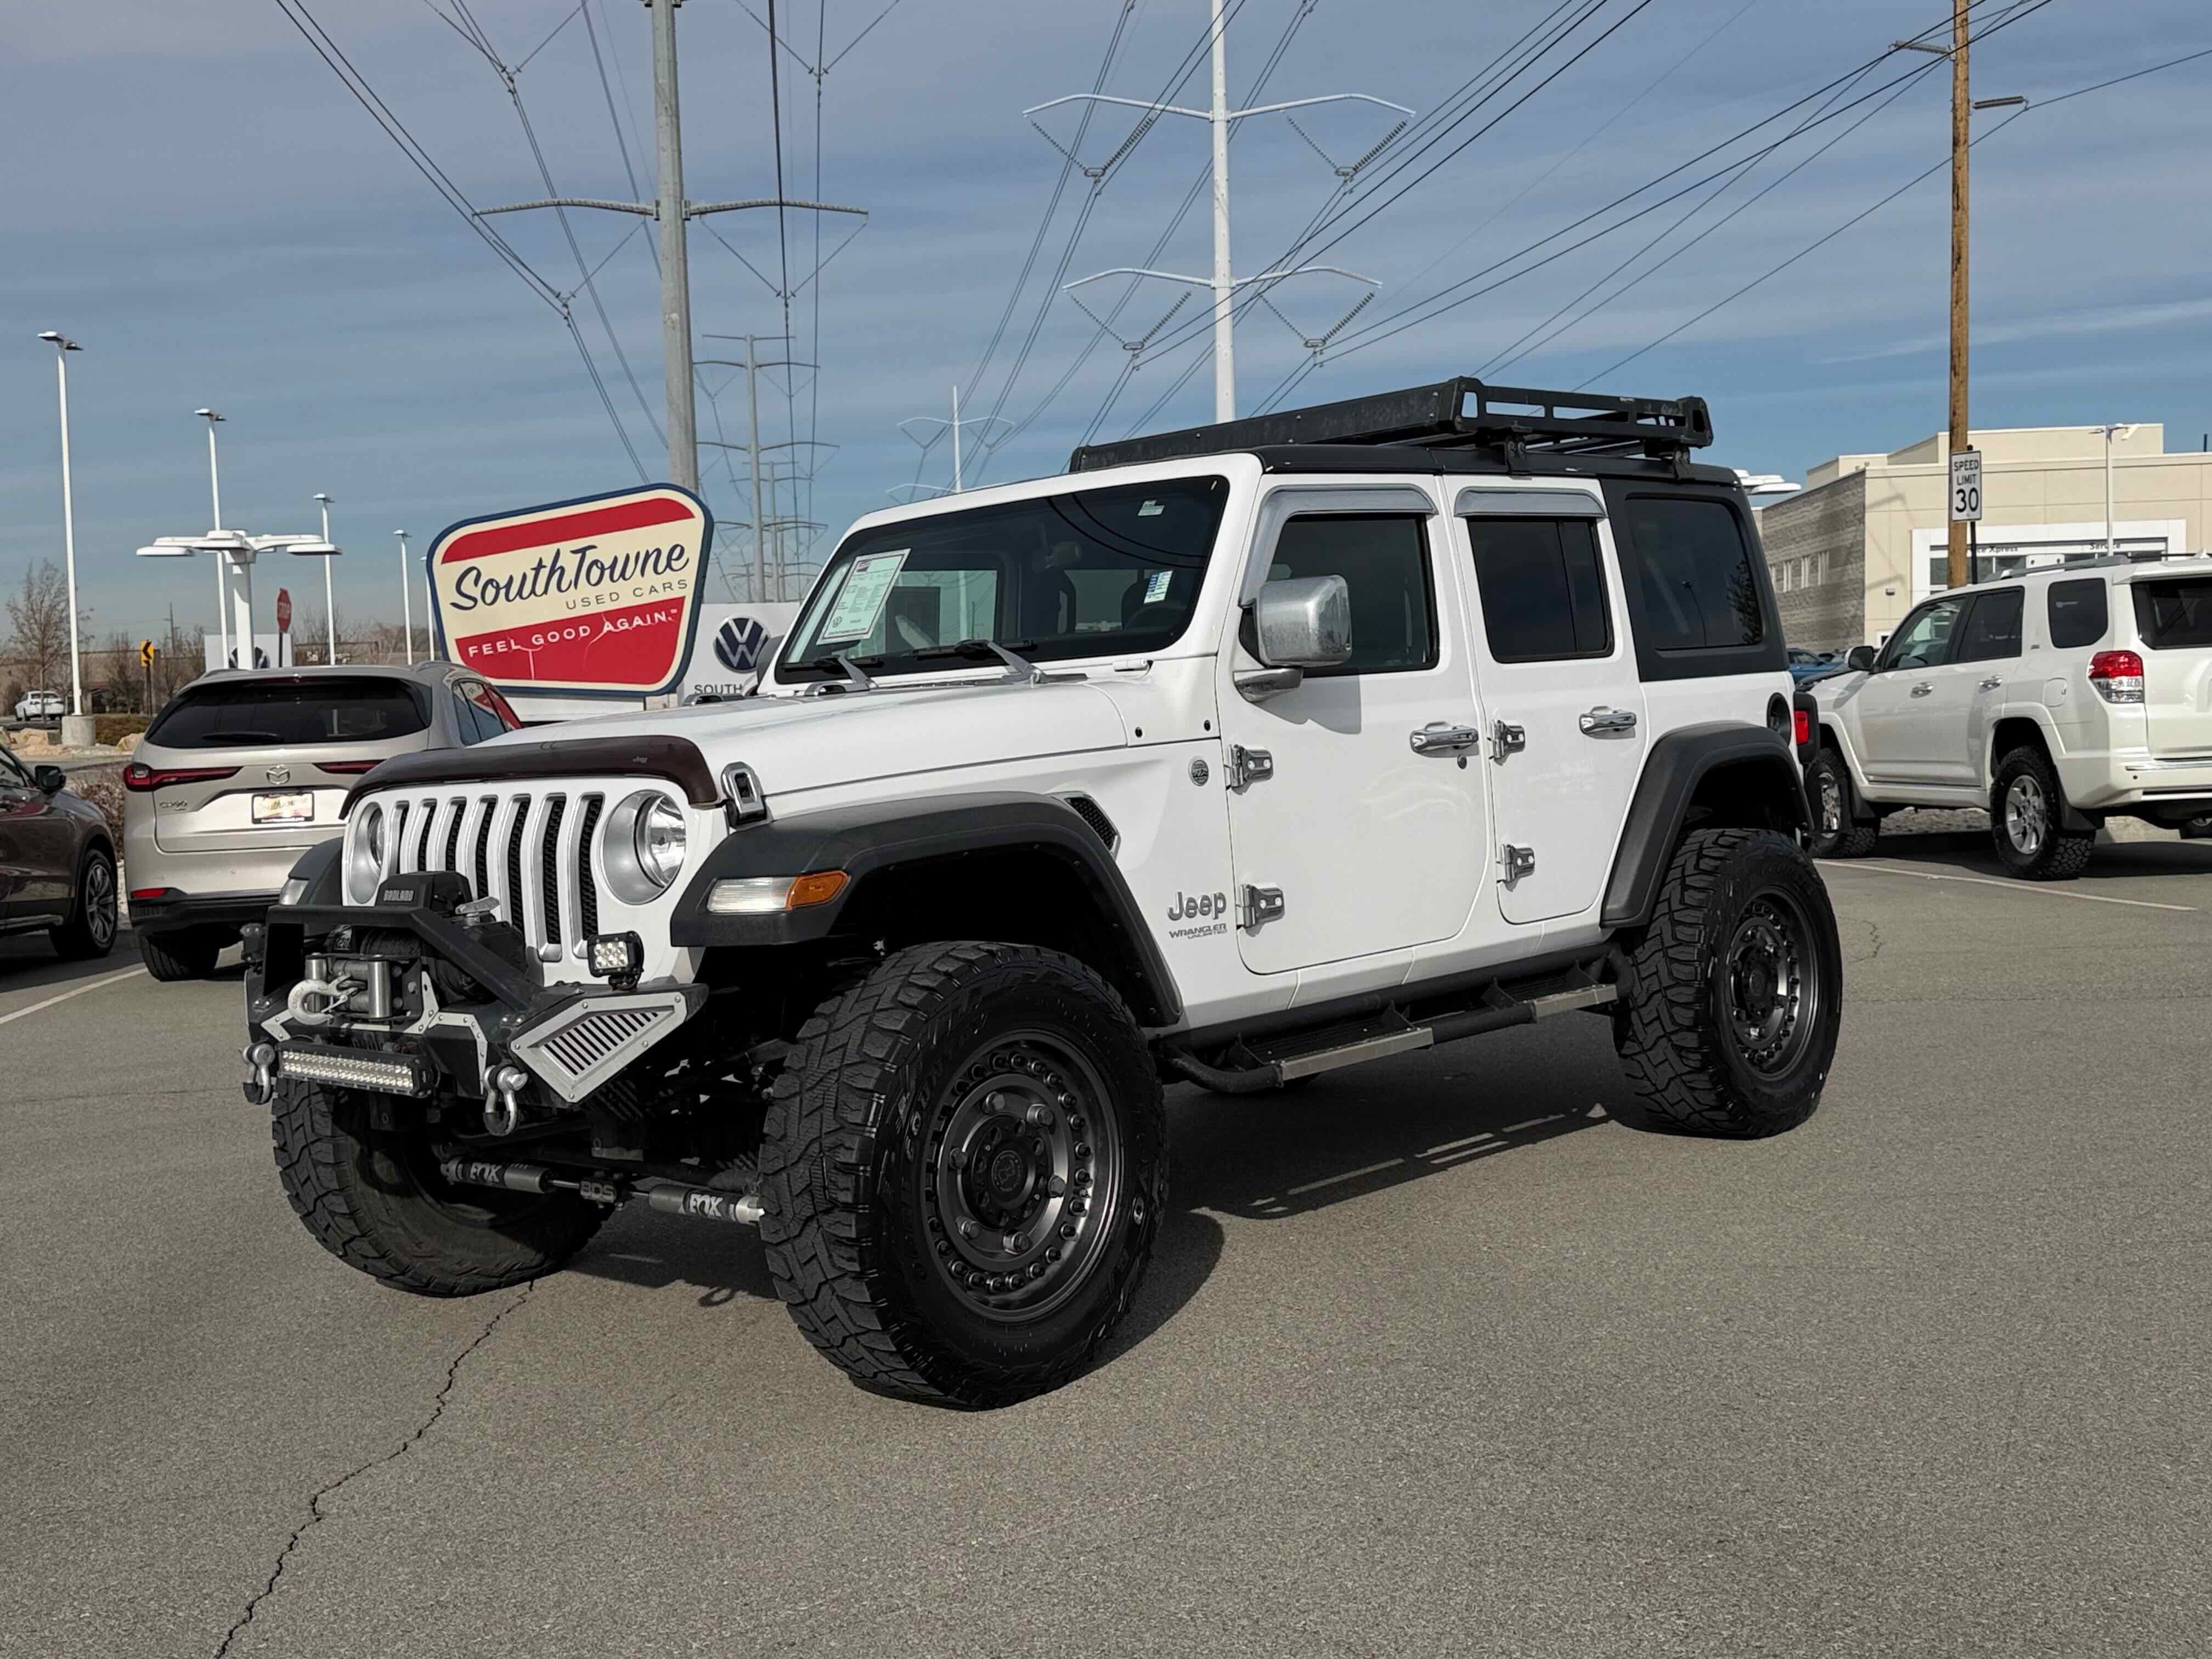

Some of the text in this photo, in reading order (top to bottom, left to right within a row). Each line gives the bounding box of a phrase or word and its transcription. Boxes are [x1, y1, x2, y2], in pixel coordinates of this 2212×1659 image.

[1954, 459, 1979, 471] SPEED
[1957, 473, 1976, 486] LIMIT
[1955, 487, 1979, 512] 30
[449, 543, 690, 611] SouthTowne
[566, 579, 688, 610] USED CARS
[468, 639, 521, 658] FEEL
[531, 625, 591, 645] GOOD
[1167, 891, 1227, 921] Jeep
[1169, 923, 1227, 939] WRANGLER
[689, 1192, 724, 1218] FOX
